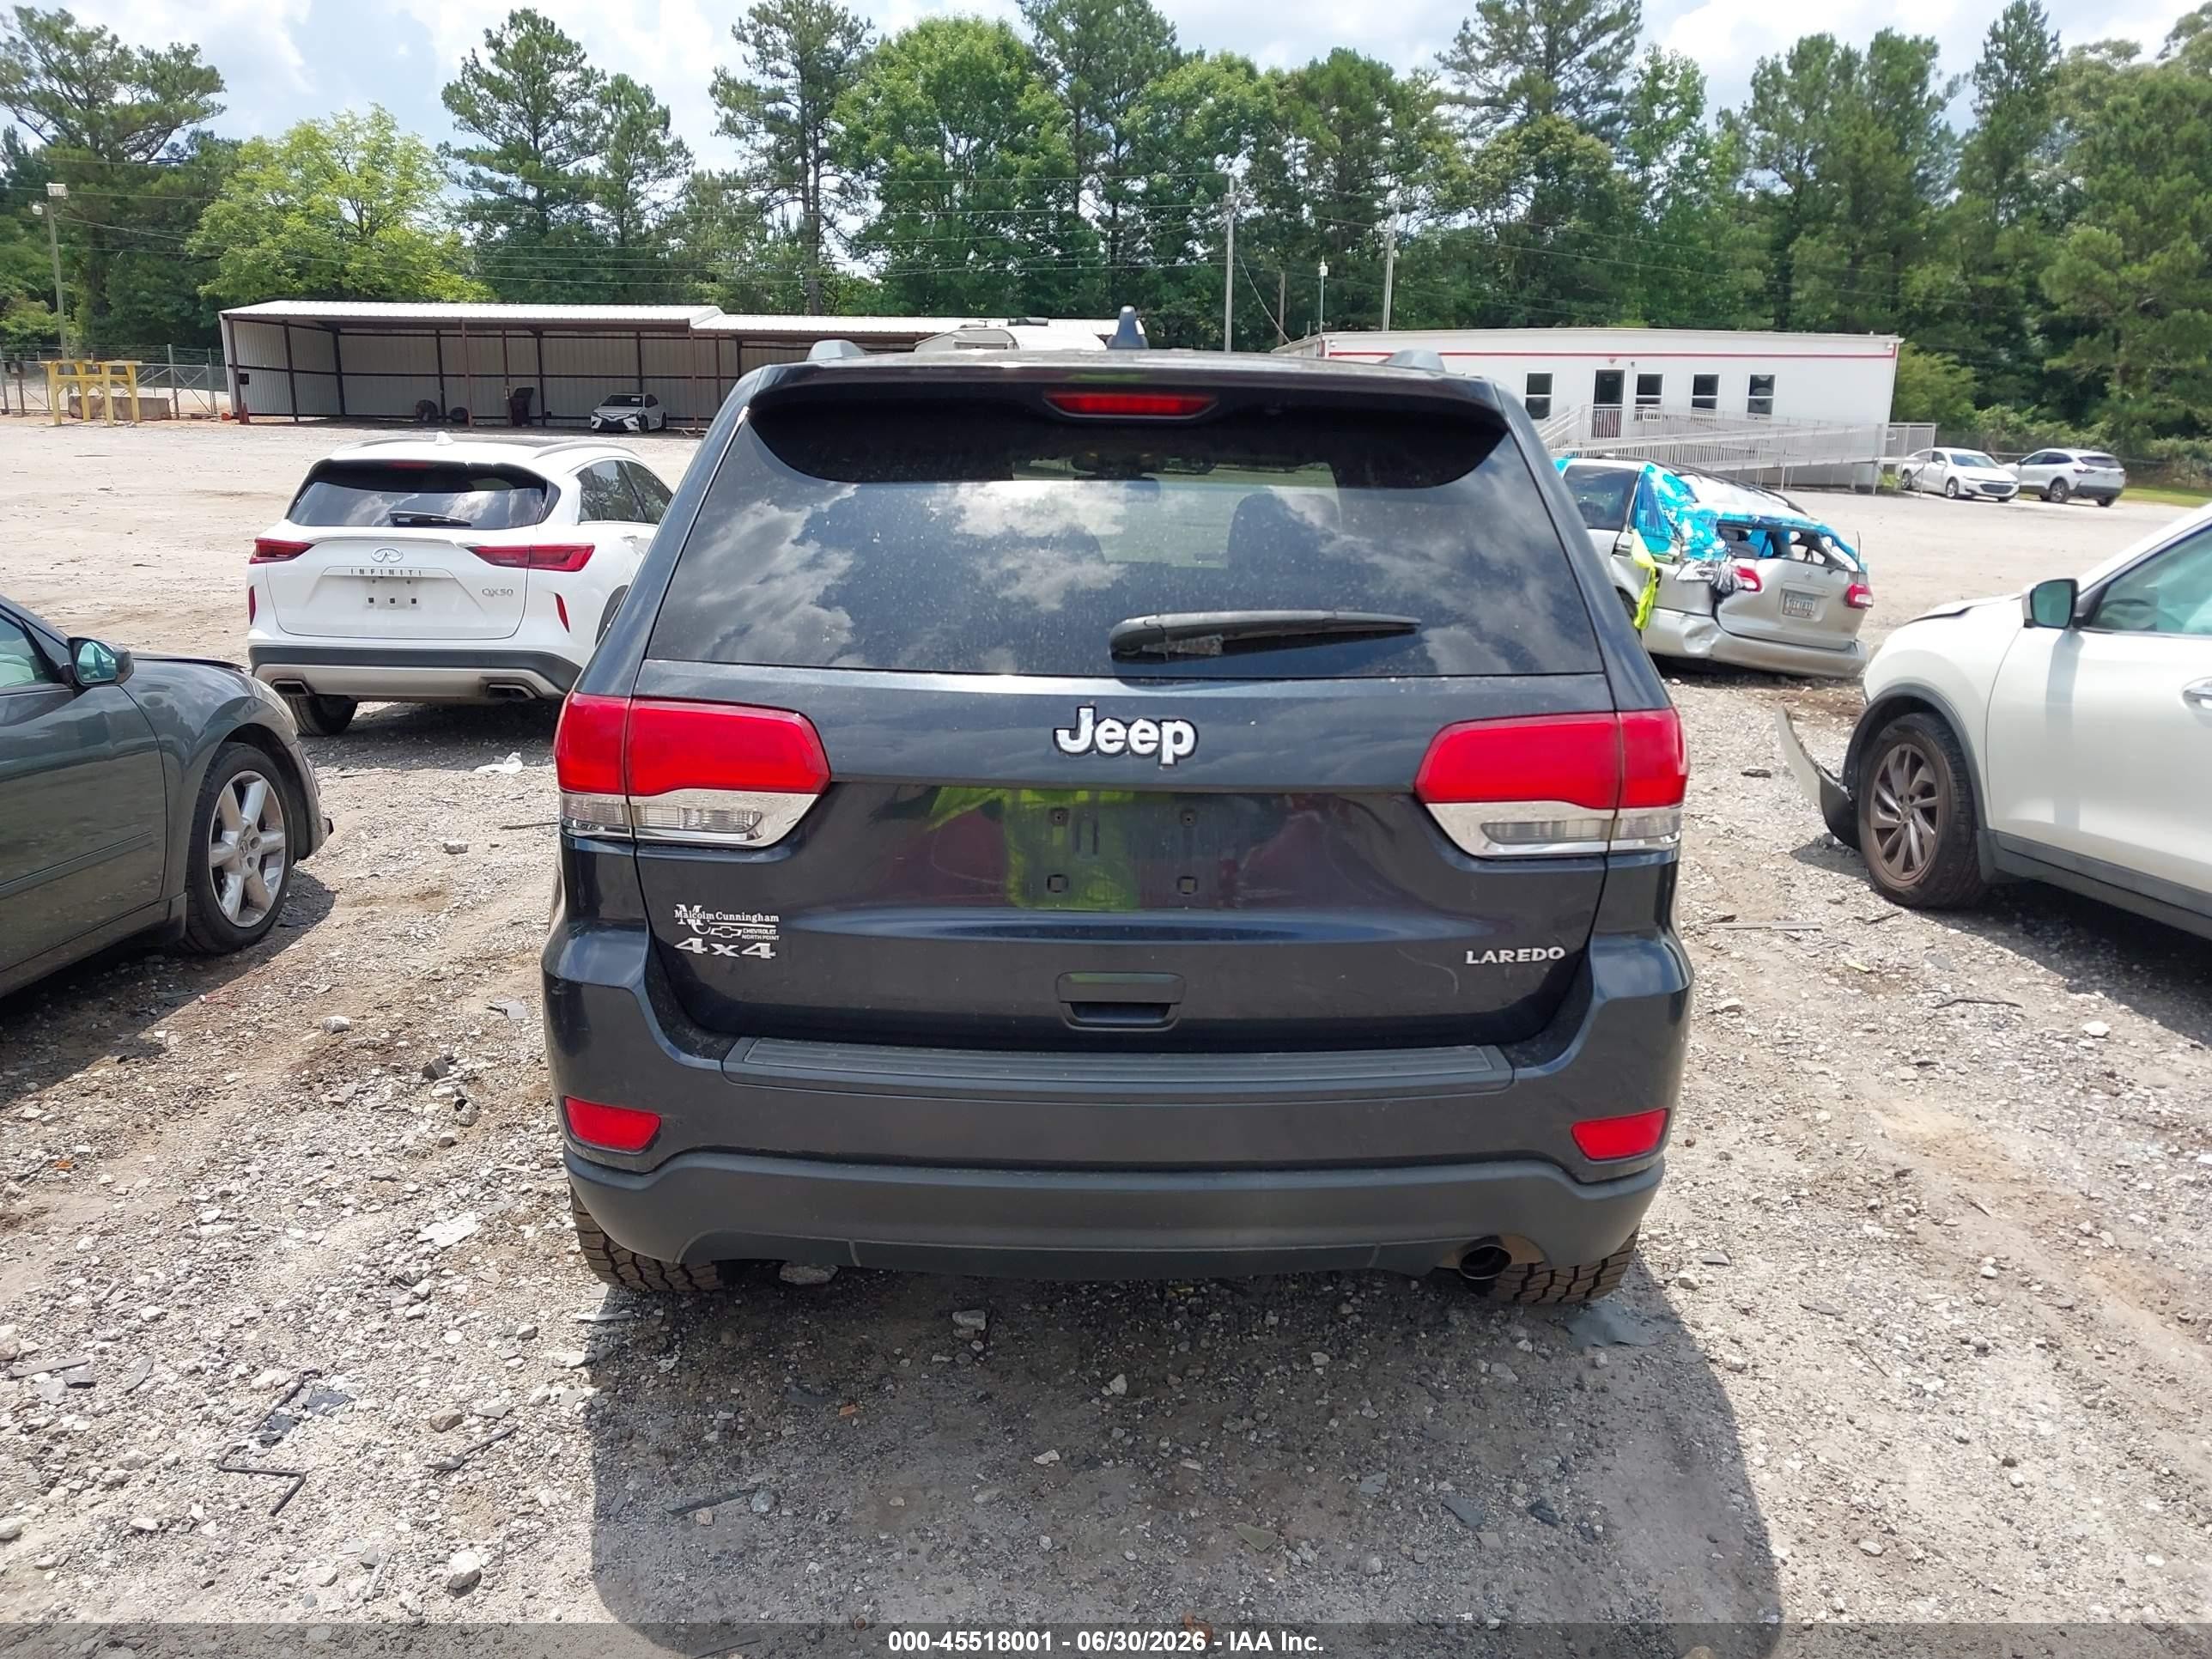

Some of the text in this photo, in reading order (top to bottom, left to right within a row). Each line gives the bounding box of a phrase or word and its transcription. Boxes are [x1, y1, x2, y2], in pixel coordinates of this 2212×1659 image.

[481, 587, 514, 597] QX50
[1054, 707, 1197, 765] Jeep
[715, 911, 780, 923] Cunningham
[1465, 946, 1565, 964] LAREDO
